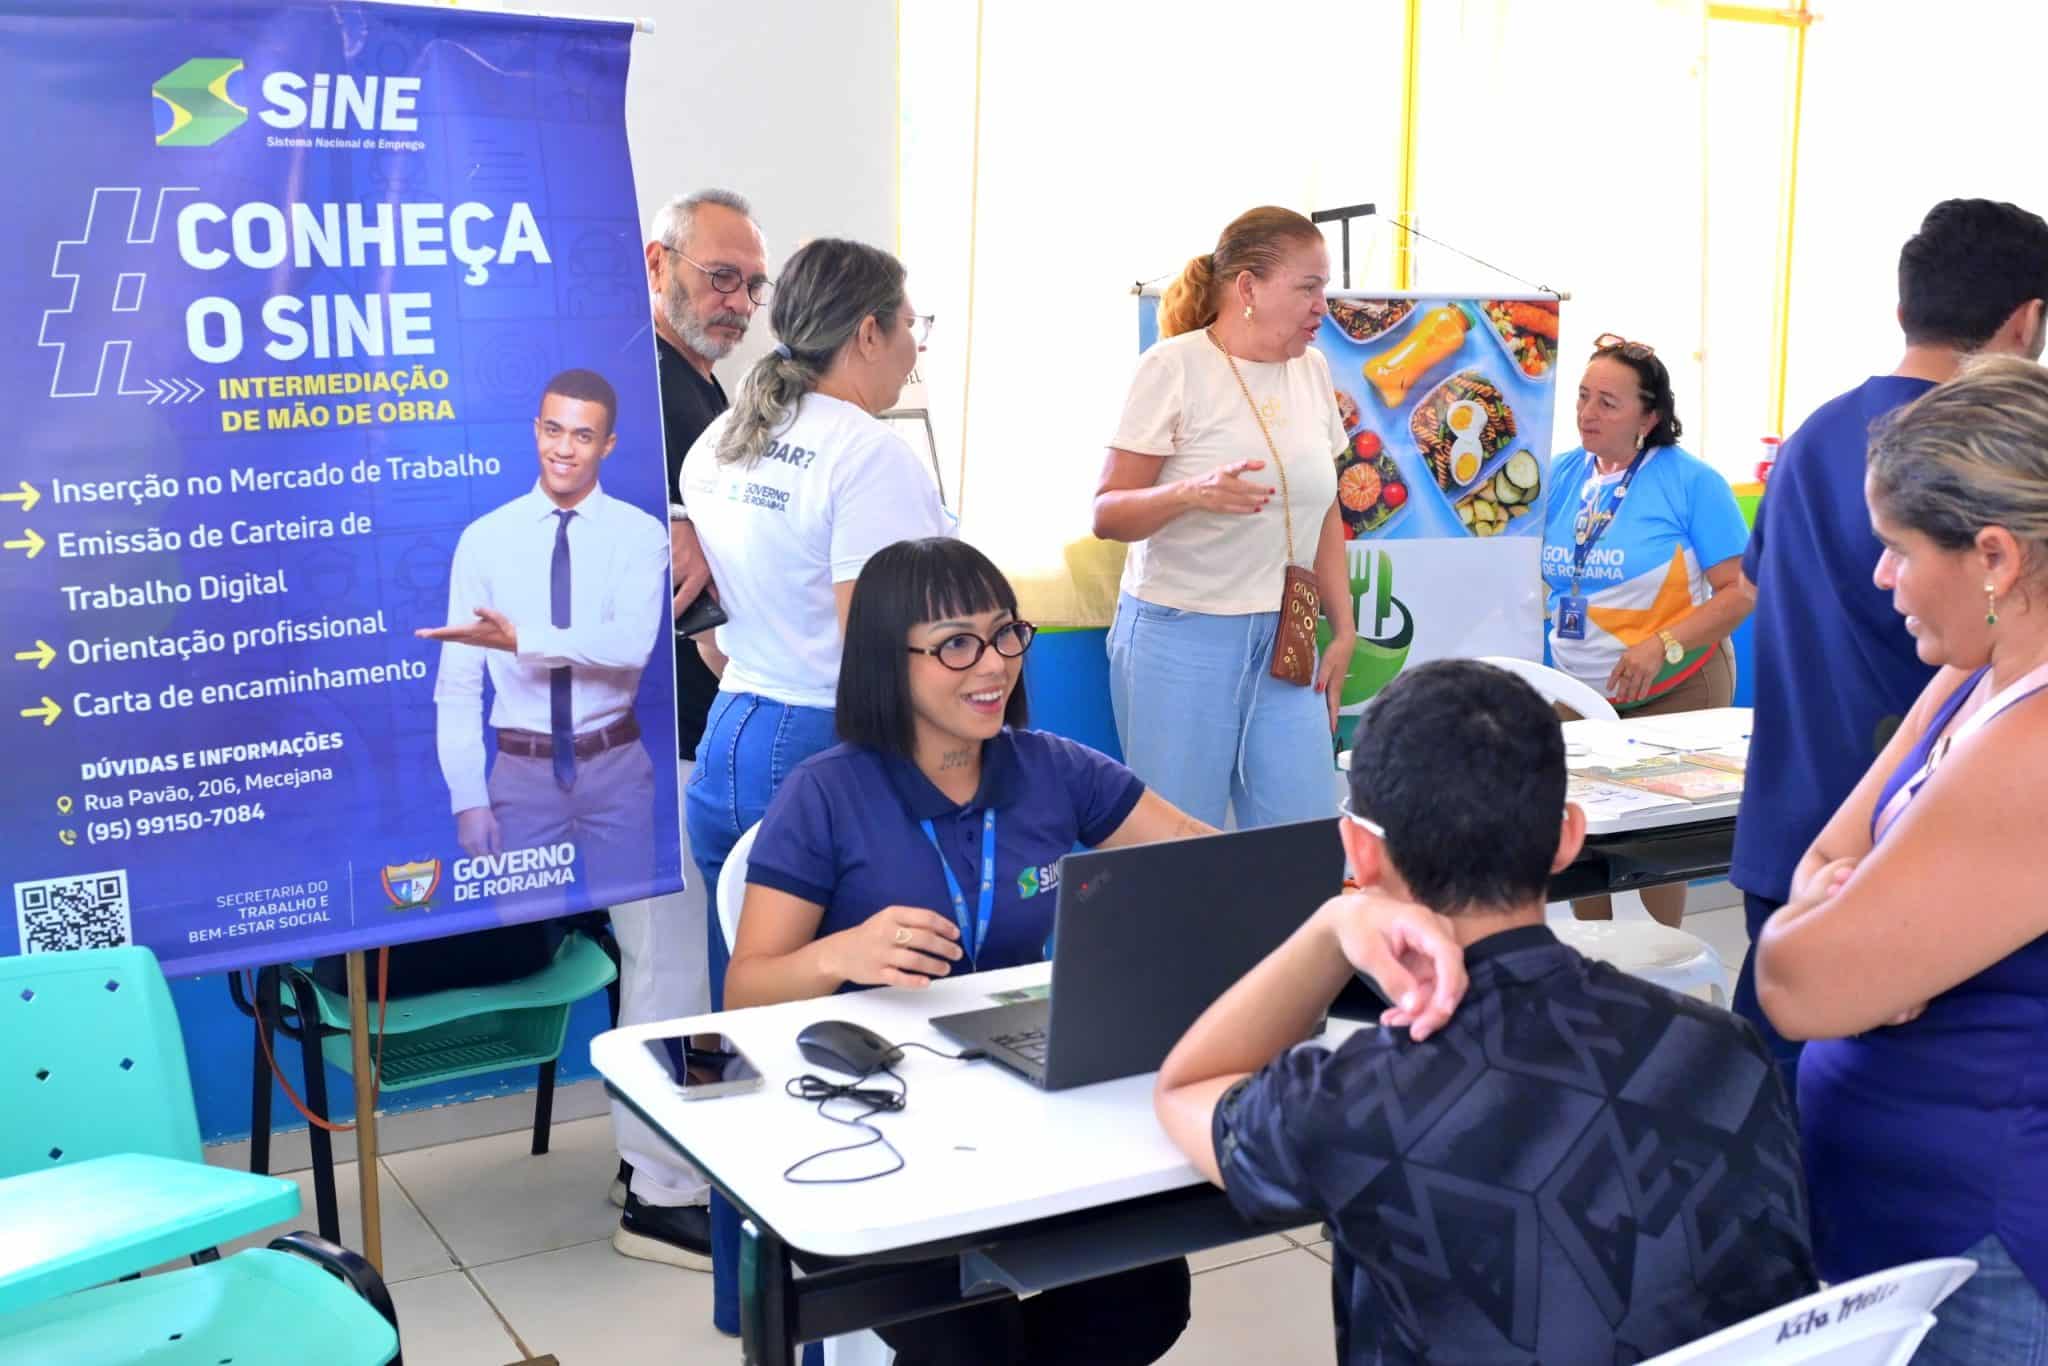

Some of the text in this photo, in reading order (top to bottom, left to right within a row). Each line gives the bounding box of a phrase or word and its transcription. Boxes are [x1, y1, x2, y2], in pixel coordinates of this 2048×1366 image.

[258, 71, 421, 132] SiNE
[266, 136, 425, 151] Sistema Nacional de Emprego
[177, 201, 551, 286] CONHEÇA
[186, 292, 436, 364] O SINE
[219, 365, 449, 397] INTERMEDIAÇÃO
[221, 398, 455, 432] DE MÃO DE OBRA
[762, 440, 816, 469] DAR?
[53, 453, 501, 505] Inserção no Mercado de Trabalho
[744, 482, 790, 503] GOVERNO
[57, 512, 372, 557] Emissão de Carteira de
[1543, 545, 1625, 566] GOVRNO
[1543, 563, 1555, 576] DE
[61, 569, 288, 611] Trabalho Digital
[67, 611, 387, 666] Orientação profissional
[73, 660, 427, 719] Carta de encaminhamento
[82, 732, 343, 780] DÚVIDAS E INFORMAÇÕES
[85, 766, 333, 812] Rua Pavão, 206, Mecejana
[86, 802, 265, 844] (95) 99150-7084
[453, 843, 575, 882] GOVERNO
[1040, 862, 1058, 886] Si
[216, 880, 329, 908] SECRETARIA DO
[454, 868, 575, 902] DE RORAIMA
[238, 895, 329, 919] TRABALHO E
[188, 911, 331, 943] BEM-ESTAR SOCIAL
